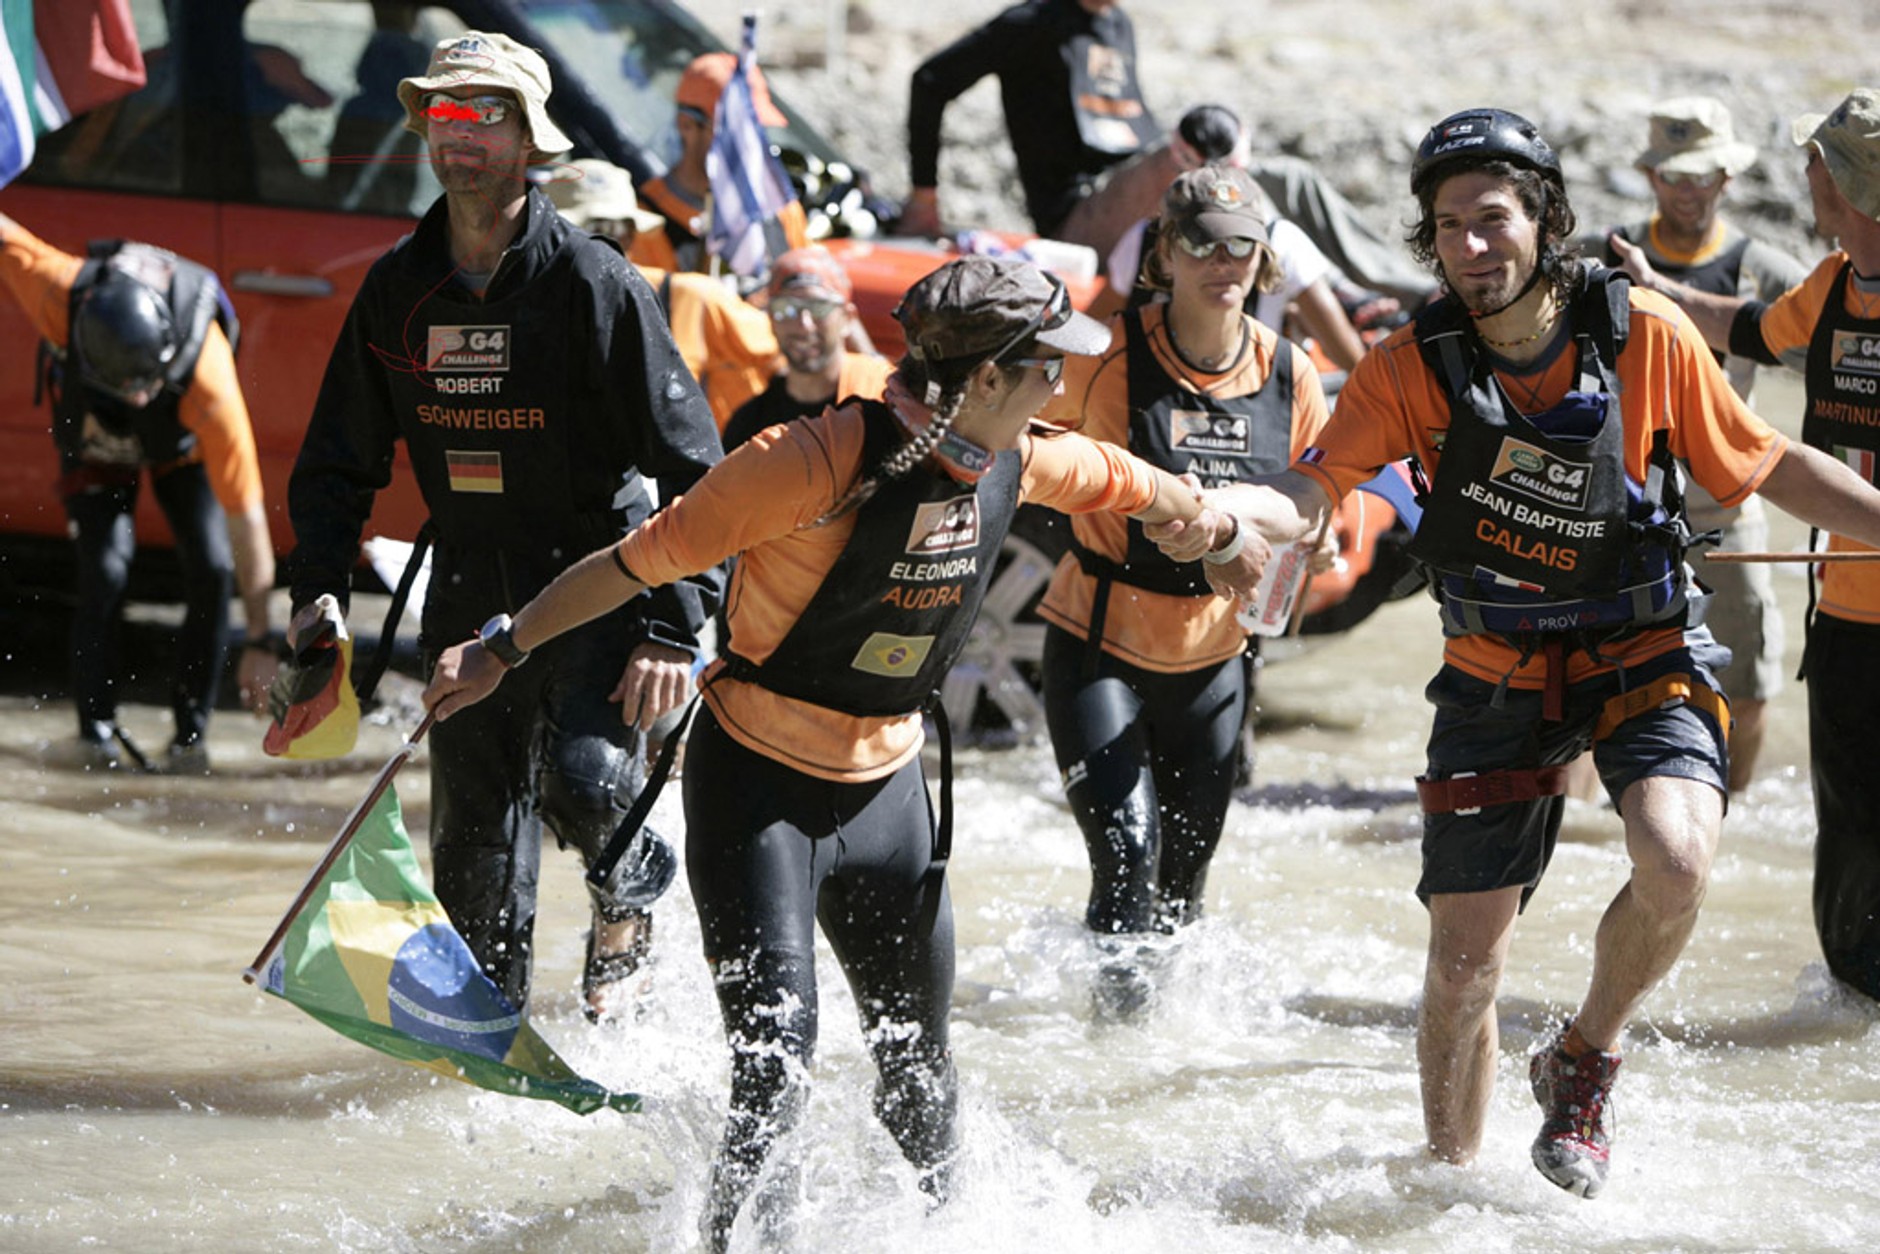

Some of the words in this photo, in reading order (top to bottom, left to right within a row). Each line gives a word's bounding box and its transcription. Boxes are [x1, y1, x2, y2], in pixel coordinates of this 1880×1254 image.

[1433, 136, 1485, 154] LAZER
[469, 331, 504, 350] G4
[441, 354, 503, 365] CHALLENGE
[435, 377, 503, 394] ROBERT
[1834, 374, 1877, 394] MARCO
[416, 404, 545, 430] SCHWEIGER
[1815, 399, 1880, 427] MARTINU
[1214, 418, 1246, 438] G4
[1187, 458, 1238, 478] ALINA
[1547, 463, 1584, 489] G4
[1510, 472, 1579, 502] CHALLENGE
[1461, 482, 1512, 516] JEAN
[1513, 504, 1606, 538] BAPTISTE
[1475, 518, 1578, 571] CALAIS
[889, 557, 977, 581] ELEONORA
[881, 584, 963, 609] AUDRA
